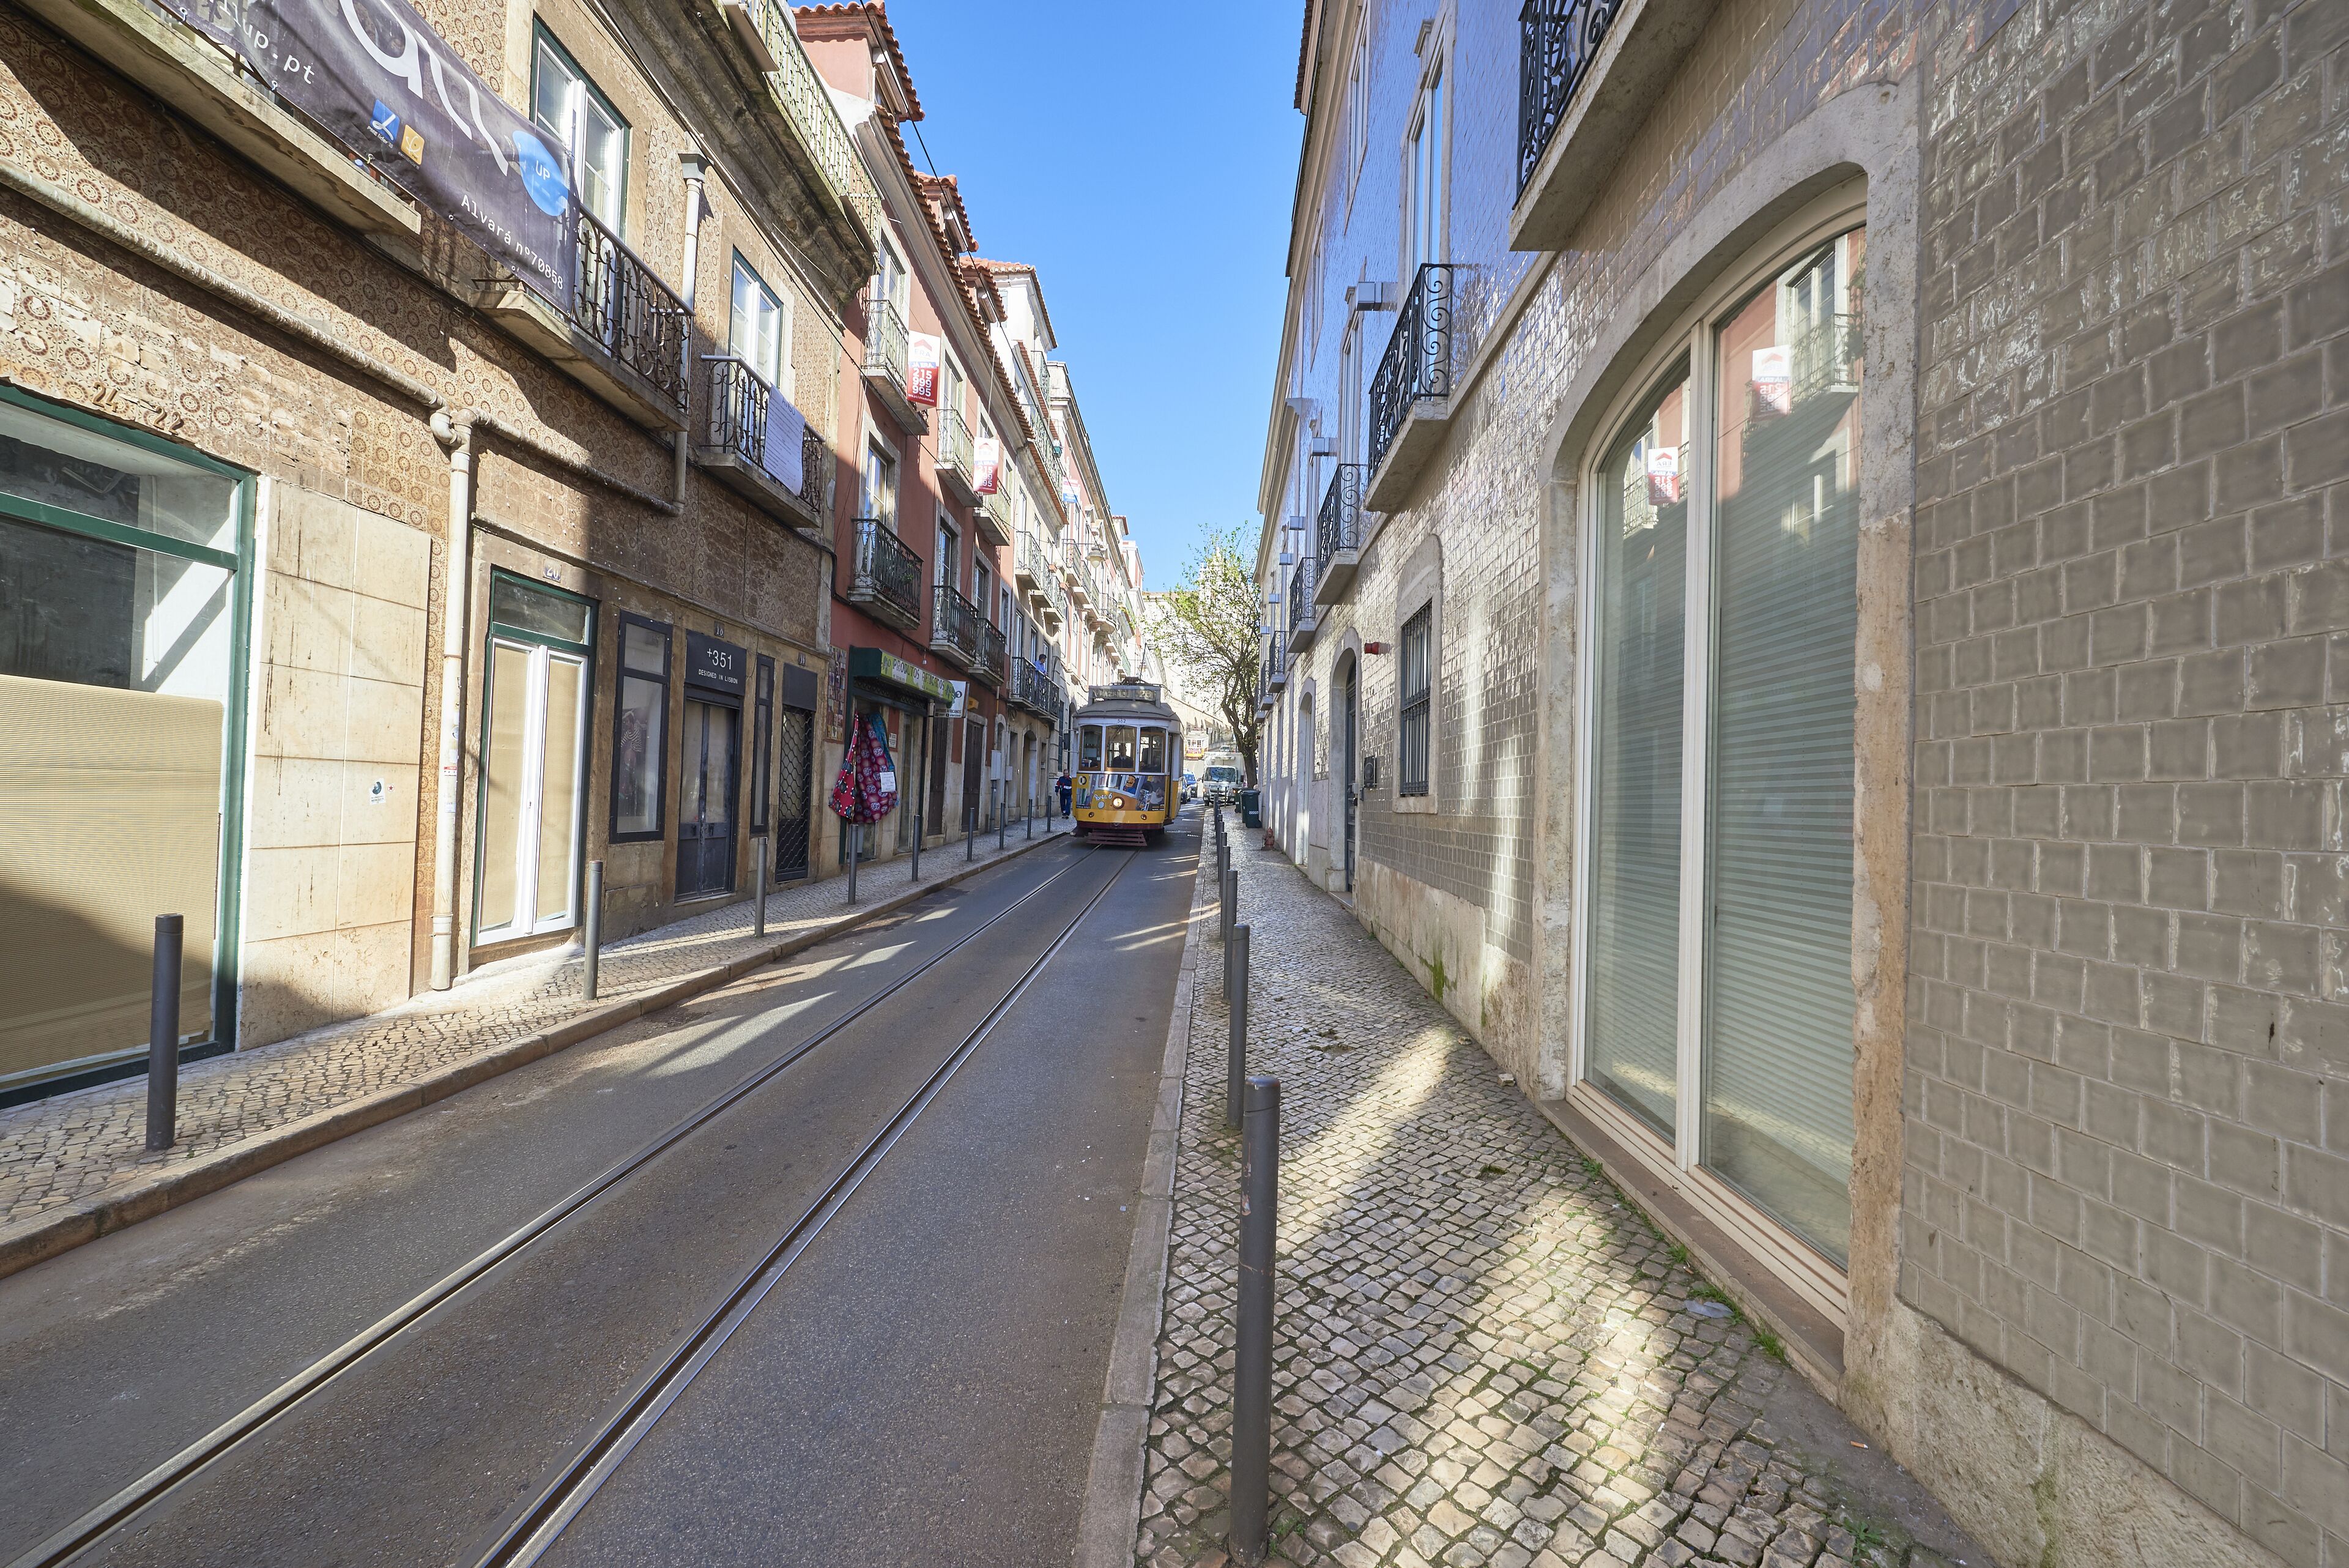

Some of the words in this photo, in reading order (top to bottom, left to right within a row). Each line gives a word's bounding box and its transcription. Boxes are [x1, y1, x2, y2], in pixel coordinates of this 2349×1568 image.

[535, 160, 551, 180] UP
[461, 195, 511, 245] Alvará
[913, 367, 932, 380] 215
[913, 376, 932, 388] 999
[92, 382, 119, 412] 24
[912, 385, 931, 397] 995
[153, 406, 183, 435] 22
[707, 648, 732, 671] +351
[892, 658, 919, 679] PRODUTOS
[699, 669, 717, 679] DESIGNED
[724, 675, 738, 685] LISBON
